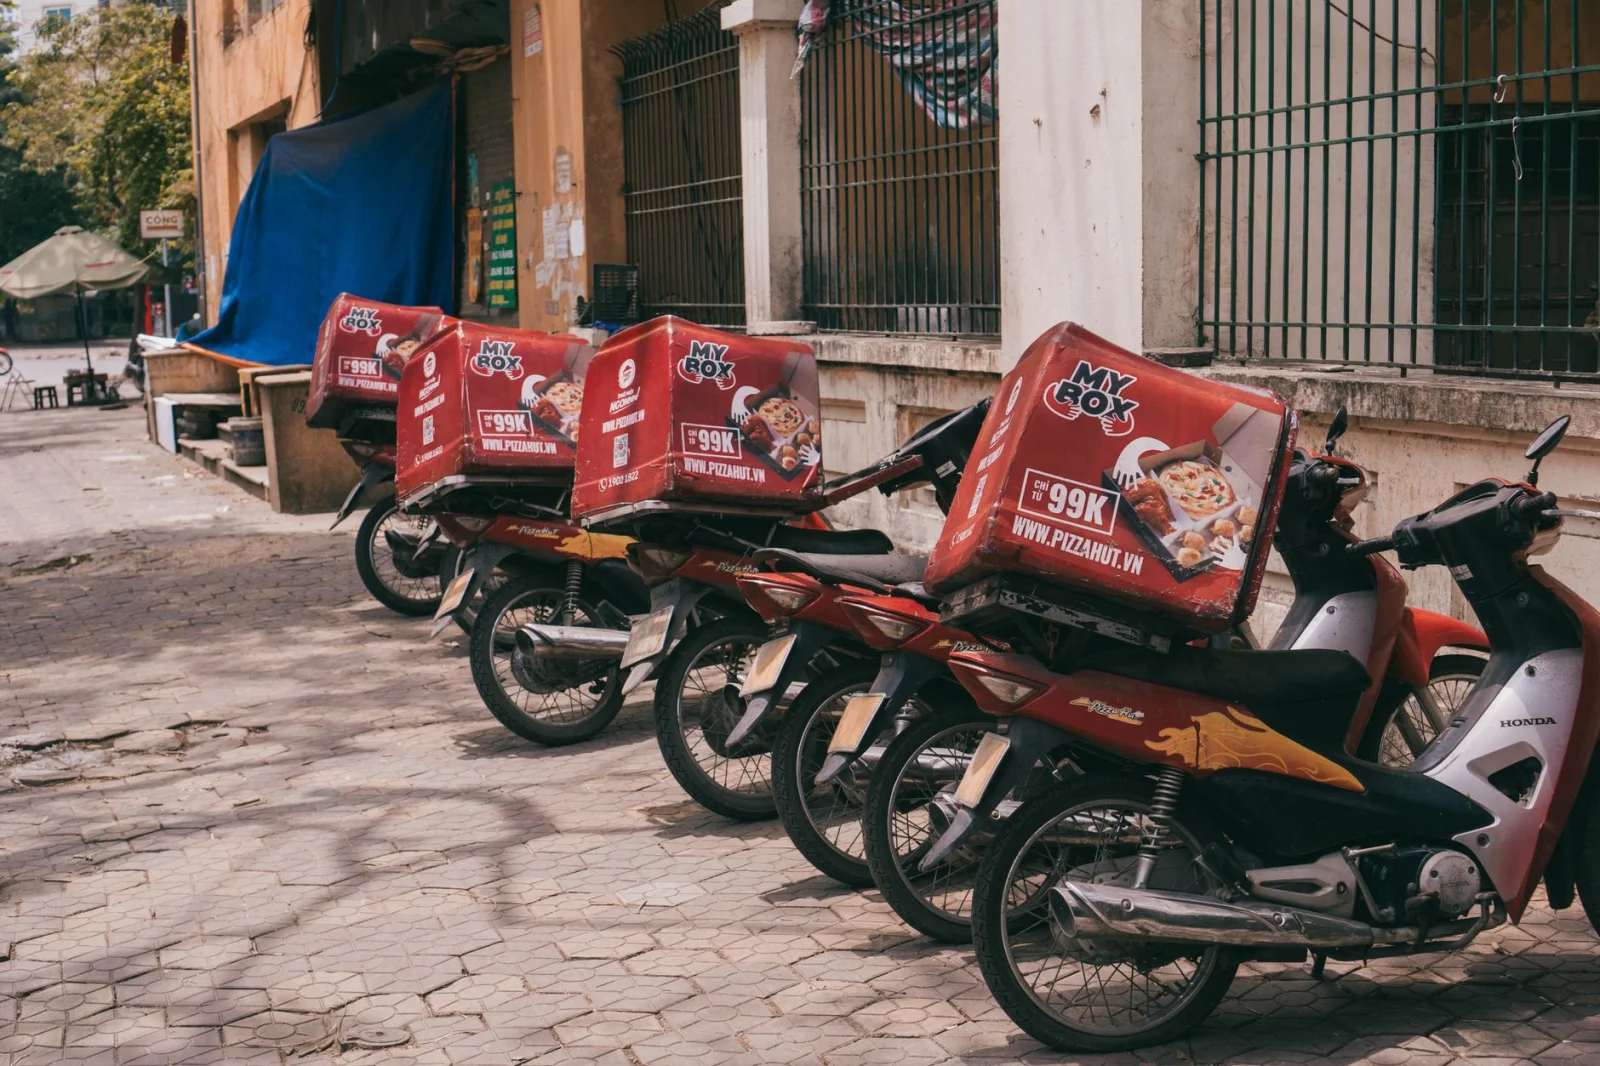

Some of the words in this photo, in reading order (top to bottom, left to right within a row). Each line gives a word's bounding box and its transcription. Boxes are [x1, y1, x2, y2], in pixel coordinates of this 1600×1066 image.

[350, 306, 379, 320] MY
[344, 317, 382, 331] BOX
[481, 340, 515, 356] MY
[691, 340, 729, 360] MY
[351, 360, 377, 374] 99K
[476, 355, 522, 371] BOX
[684, 356, 735, 379] BOX
[1071, 360, 1137, 396] MY
[1055, 379, 1139, 423] BOX
[494, 414, 528, 432] 99K
[481, 438, 557, 454] WWW.PIZZAHUT.VN
[698, 429, 734, 453] 99K
[684, 458, 765, 483] WWW.PIZZAHUT.VN
[1034, 480, 1050, 491] CHỈ
[1032, 489, 1044, 500] TỪ
[1047, 483, 1108, 526] 99K
[1012, 514, 1144, 576] WWW.PIZZAHUT.VN
[1088, 700, 1118, 715] Pizza
[1500, 717, 1557, 728] HONDA
